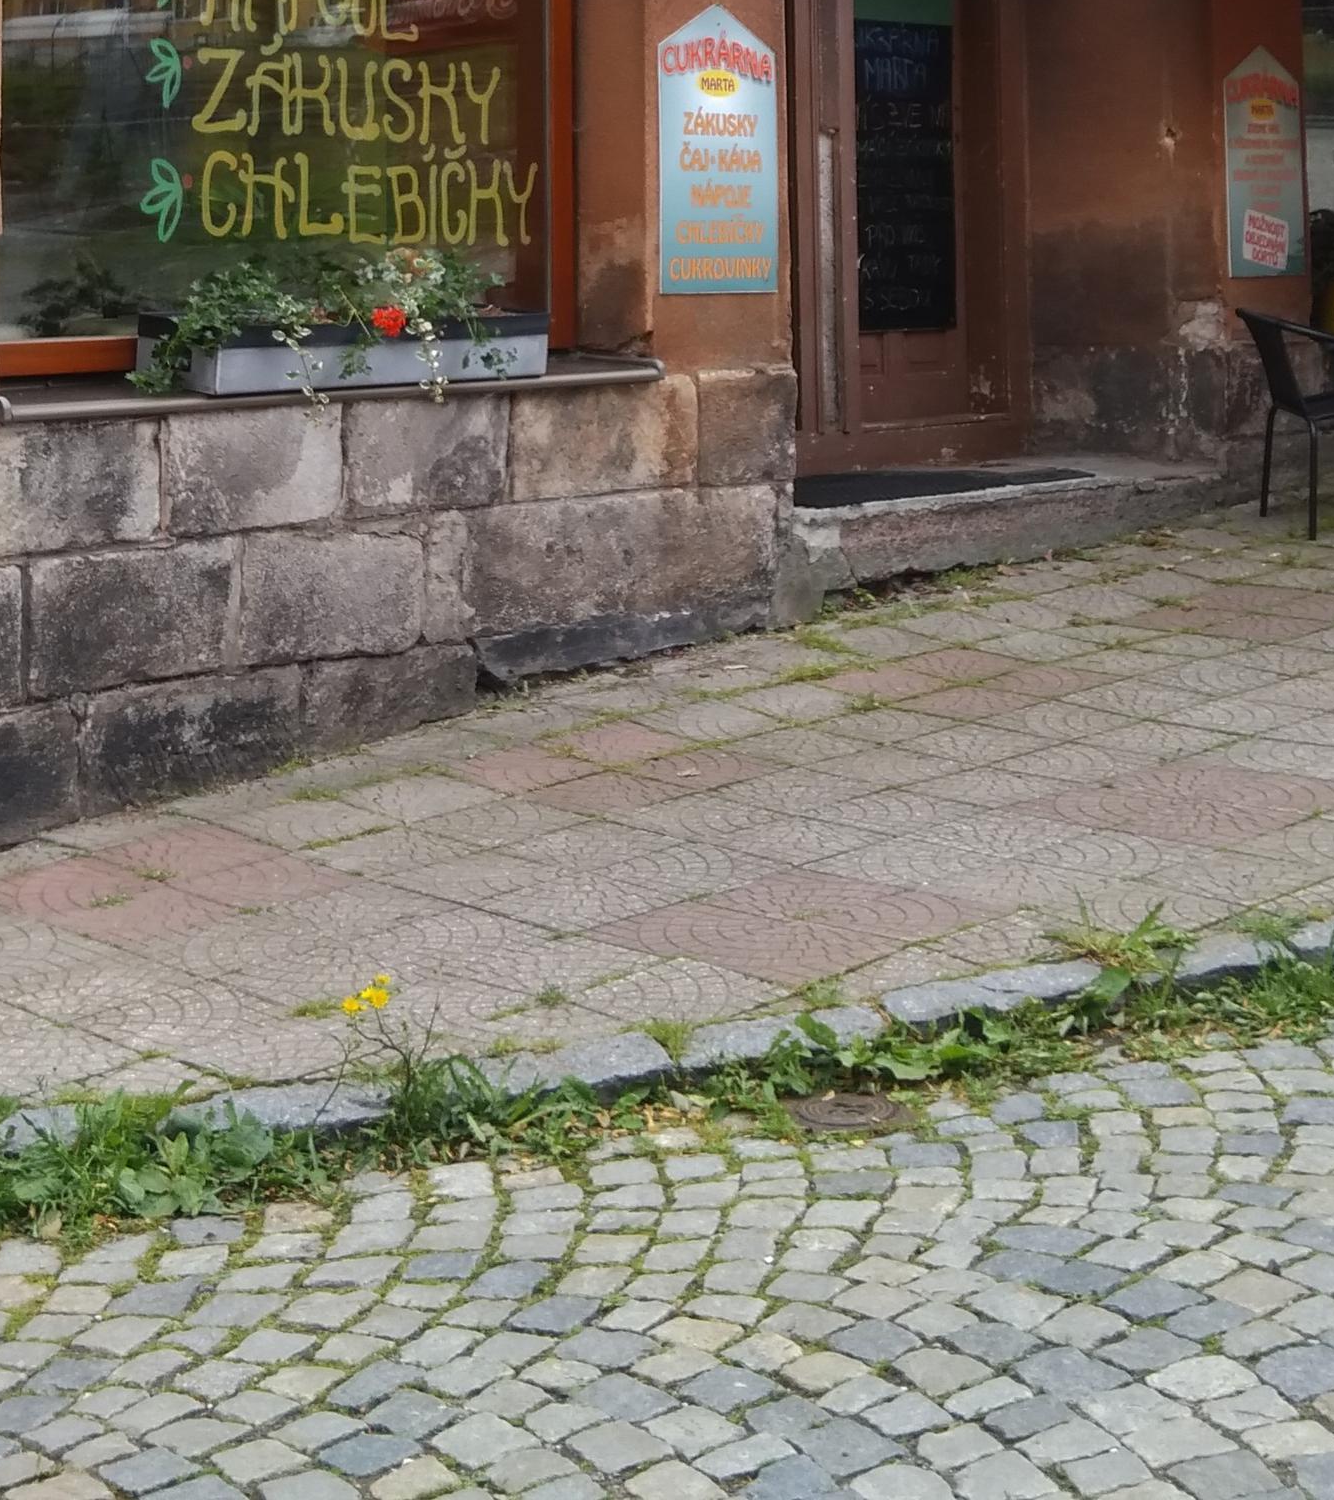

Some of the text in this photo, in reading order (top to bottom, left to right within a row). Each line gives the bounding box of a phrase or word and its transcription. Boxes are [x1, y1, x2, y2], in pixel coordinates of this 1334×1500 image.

[662, 29, 773, 83] CUKRÁRNA
[191, 33, 501, 145] ZÁKUSKY
[701, 77, 735, 92] MARTA
[683, 106, 759, 136] ZÁKUSKY
[200, 143, 539, 247] CHLEBÍČKY
[668, 257, 772, 282] CUKROVINKY
